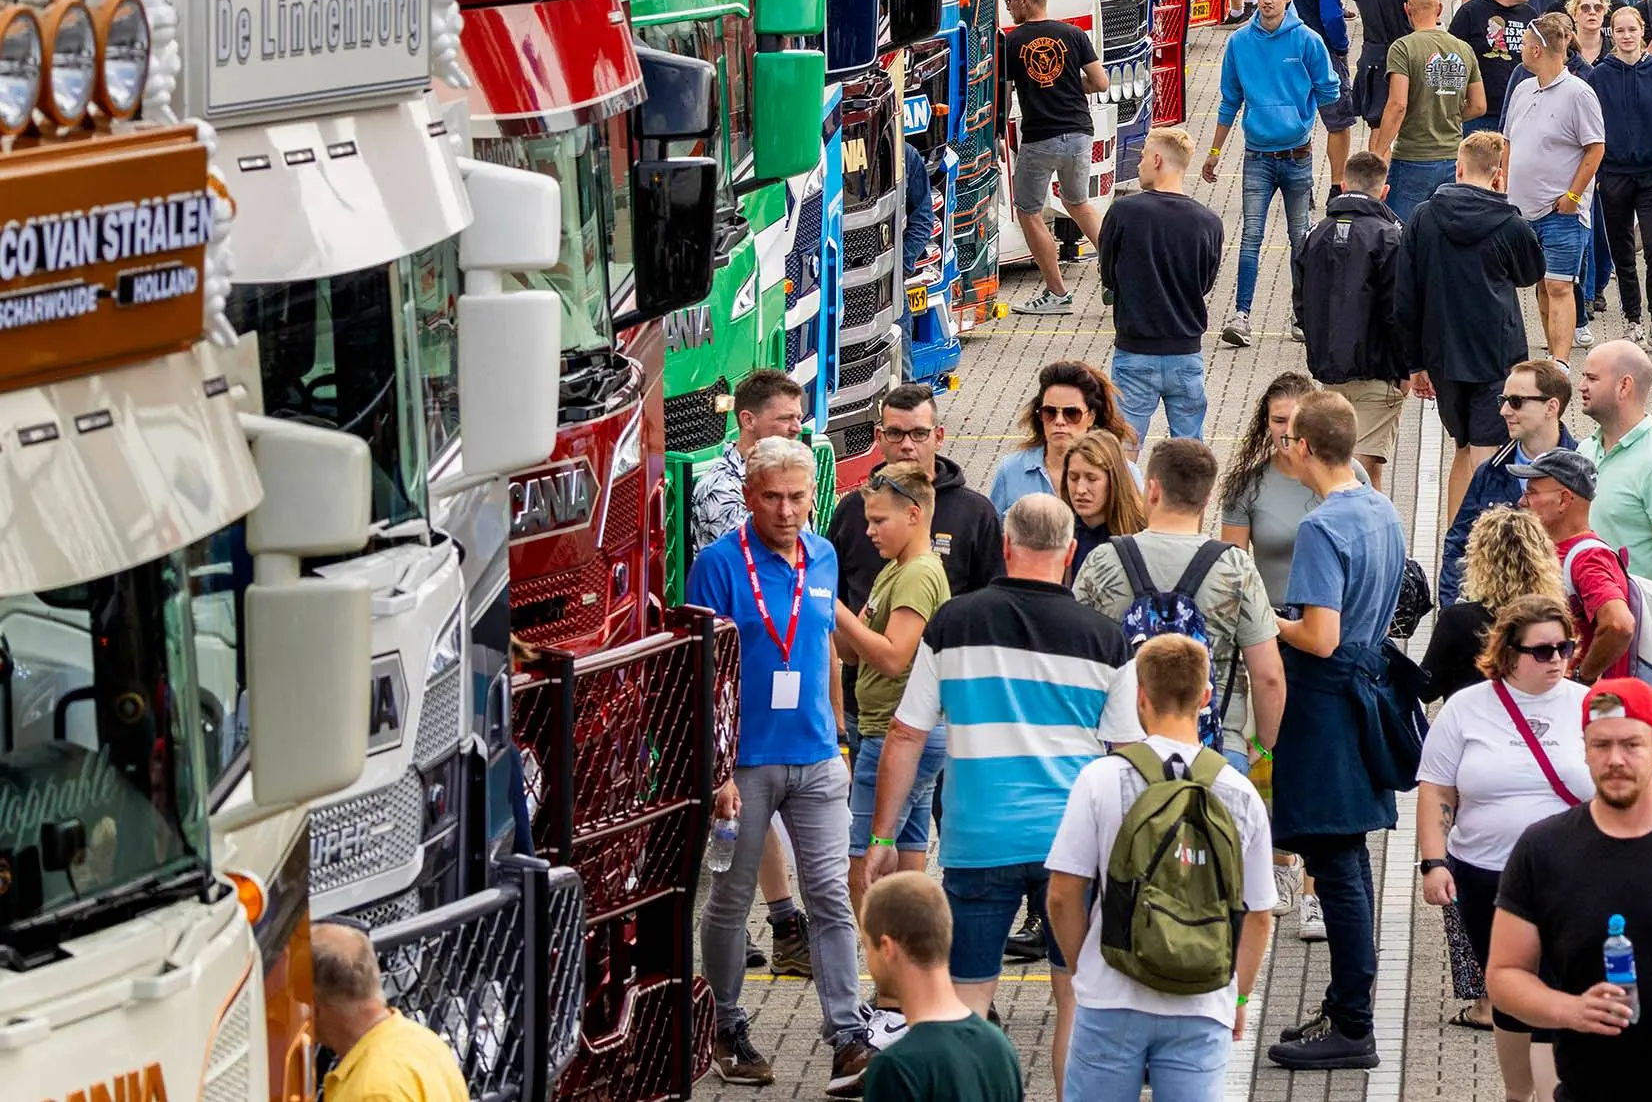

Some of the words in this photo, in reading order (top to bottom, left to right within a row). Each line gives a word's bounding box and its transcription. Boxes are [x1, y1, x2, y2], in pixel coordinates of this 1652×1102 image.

[1504, 27, 1514, 36] IS
[0, 220, 39, 281] CO
[43, 214, 98, 273] VAN
[102, 195, 215, 262] STRALEN
[133, 266, 198, 304] HOLLAND
[664, 304, 714, 353] ANIA
[508, 468, 590, 536] CANIA
[310, 820, 371, 868] UPER
